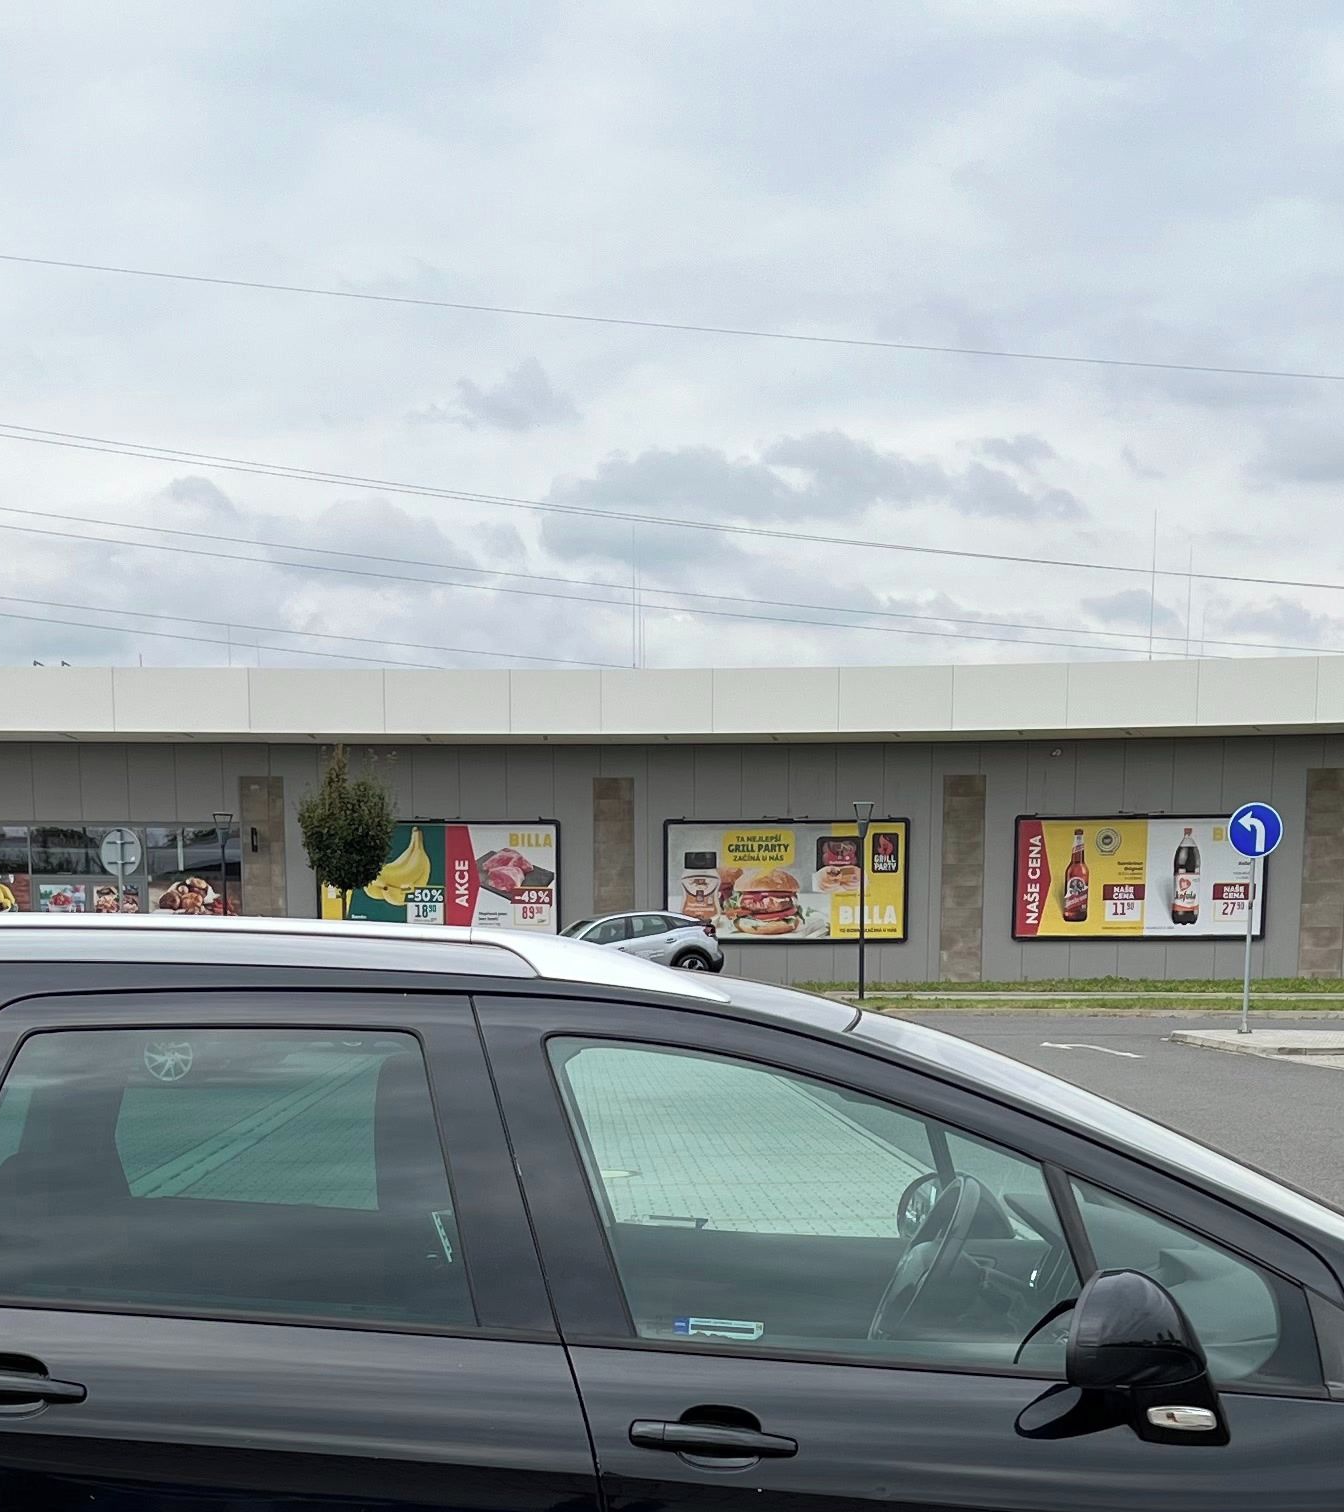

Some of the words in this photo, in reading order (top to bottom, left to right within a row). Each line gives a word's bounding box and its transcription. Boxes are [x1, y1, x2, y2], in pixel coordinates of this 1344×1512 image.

[509, 832, 553, 848] BILLA
[727, 844, 755, 853] GRILL
[757, 843, 790, 853] PARTY
[874, 854, 896, 863] GRILL
[1027, 835, 1042, 880] CENA
[873, 863, 897, 871] PARTY
[454, 859, 469, 908] AKCE
[407, 889, 444, 902] -50%
[514, 890, 550, 903] -49%
[1023, 883, 1040, 924] NAŠE
[839, 905, 897, 925] BILLA
